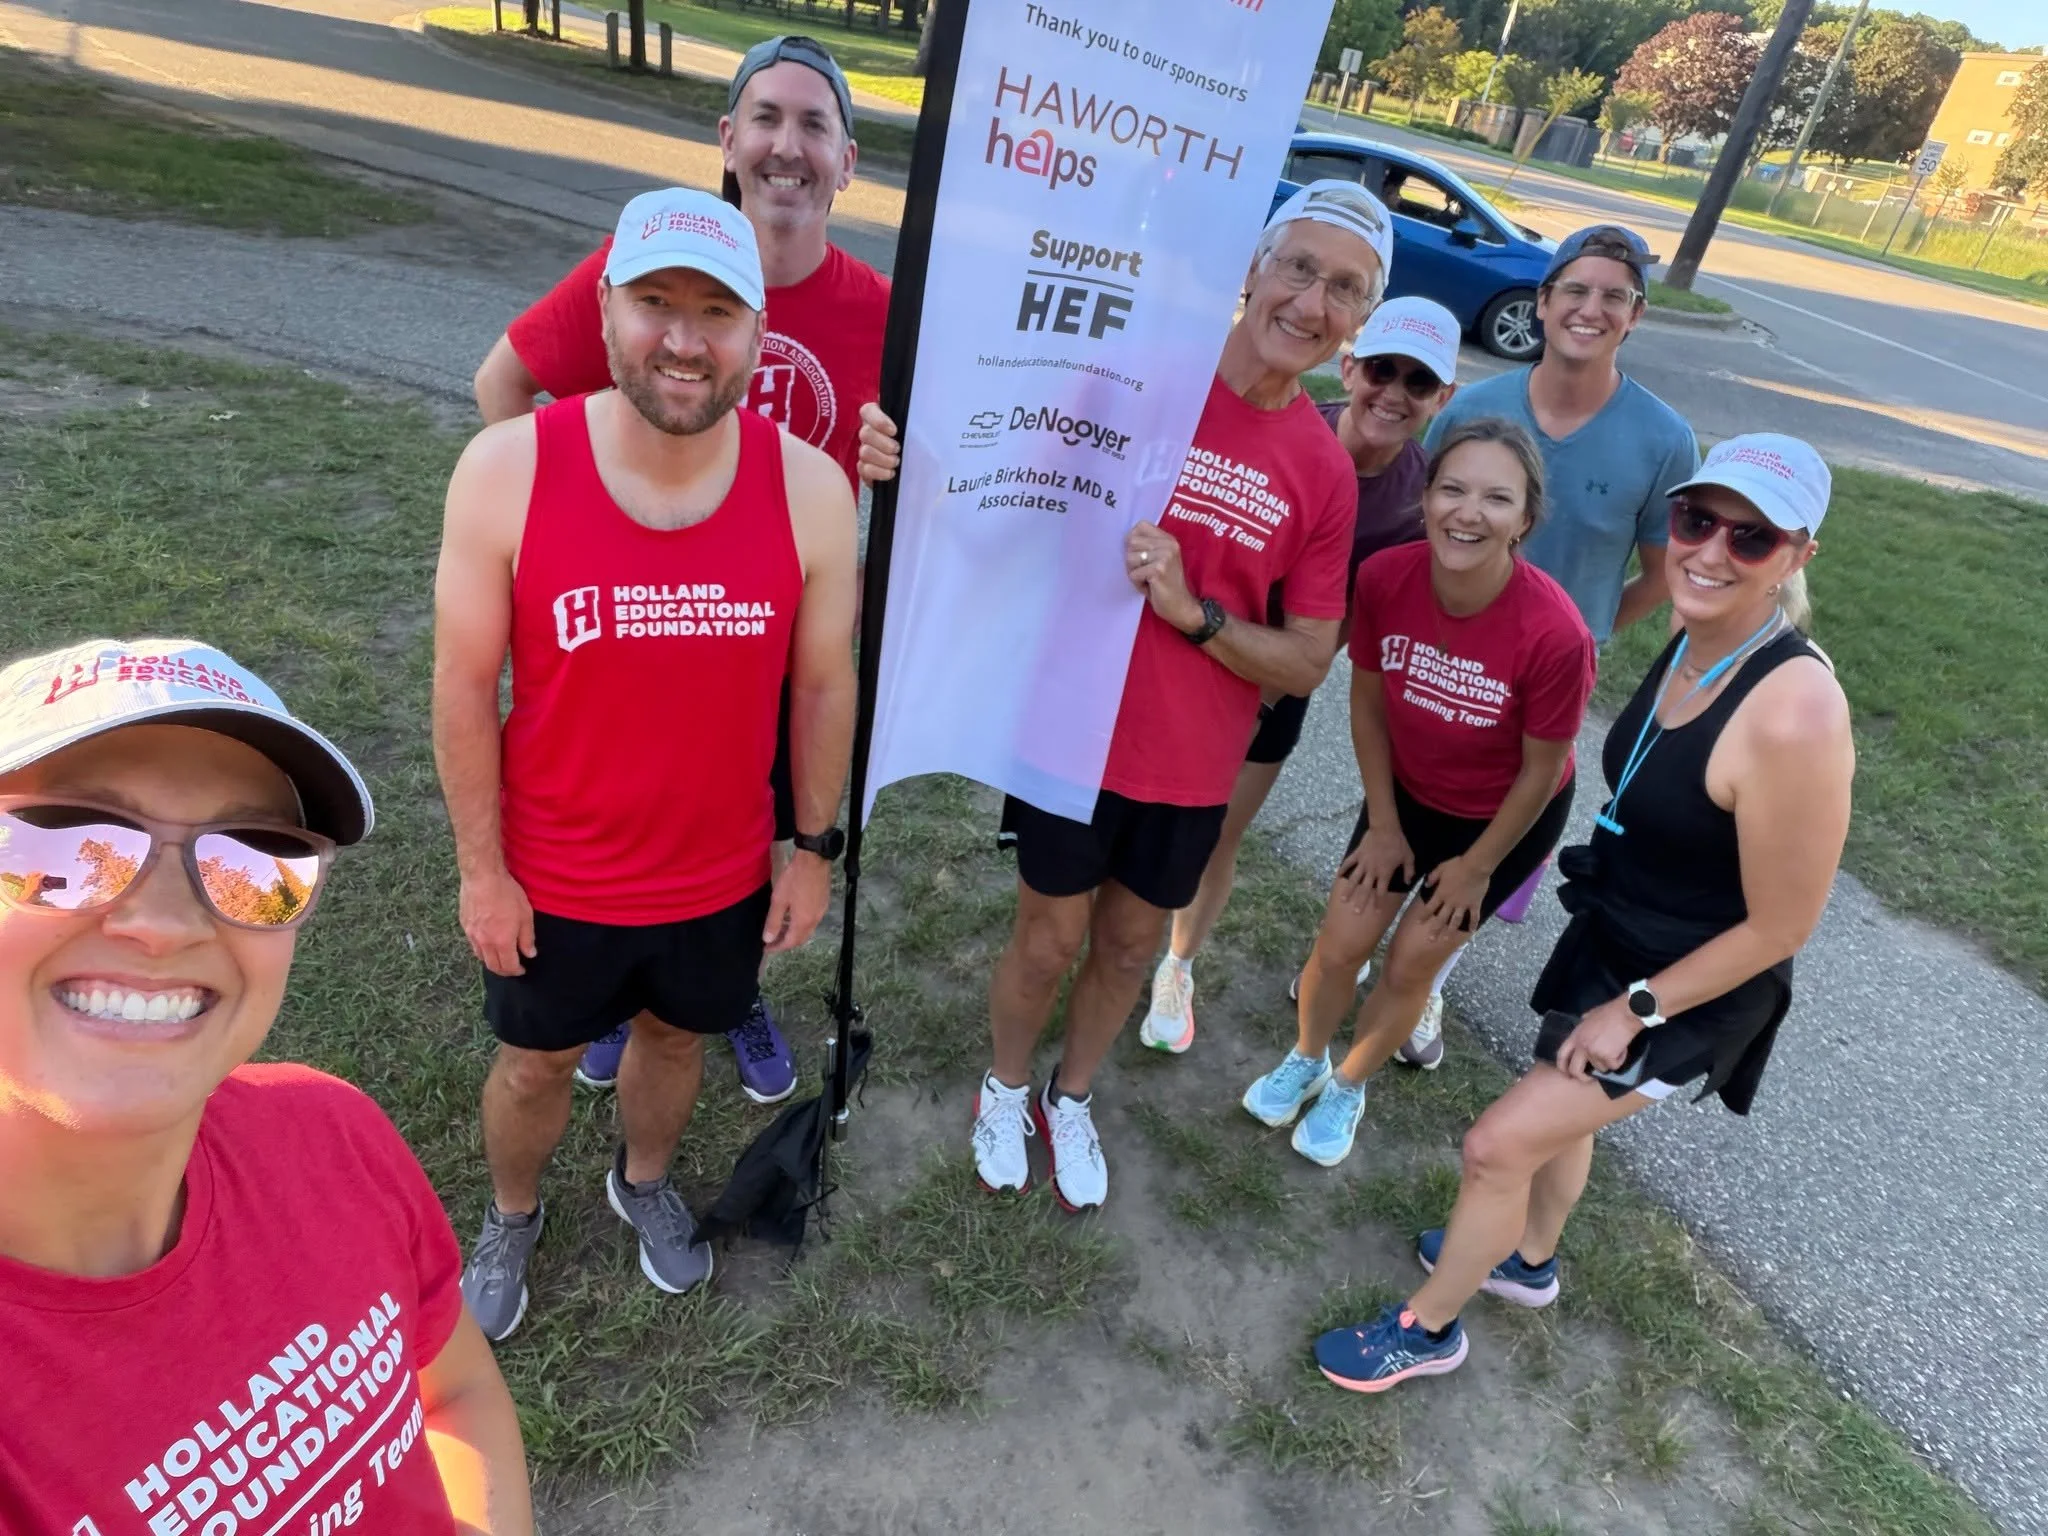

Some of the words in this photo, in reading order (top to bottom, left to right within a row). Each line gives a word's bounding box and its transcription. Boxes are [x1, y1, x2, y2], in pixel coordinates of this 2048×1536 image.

[1025, 3, 1082, 41] Thank
[1087, 29, 1118, 55] you
[1122, 38, 1139, 60] to
[1143, 48, 1168, 72] our
[1169, 60, 1248, 103] sponsors
[994, 65, 1244, 180] HAWORTH
[985, 117, 1097, 190] helps
[1919, 158, 1936, 172] 50
[670, 211, 721, 229] HOLLAND
[1030, 229, 1143, 279] Support
[1016, 282, 1133, 340] HEF
[788, 348, 831, 418] ASSOCIATION
[1008, 405, 1132, 453] DeNooyer
[947, 472, 992, 494] Laurie
[994, 466, 1068, 489] Birkholz
[1072, 475, 1102, 499] MD
[1104, 489, 1118, 509] &
[1182, 461, 1290, 517] EDUCATIONAL
[1188, 446, 1269, 487] HOLLAND
[977, 491, 1069, 514] Associates
[1178, 474, 1282, 527] FOUNDATION
[1168, 503, 1229, 537] Running
[1229, 525, 1266, 553] Team
[613, 583, 726, 602] HOLLAND
[614, 601, 775, 621] EDUCATIONAL
[615, 620, 765, 639] FOUNDATION
[118, 655, 243, 690] HOLLAND
[1410, 654, 1512, 698] EDUCATIONAL
[1413, 641, 1484, 675] HOLLAND
[1403, 689, 1456, 722] Running
[1458, 709, 1498, 728] Team
[1408, 666, 1504, 706] FOUNDATION
[124, 1323, 328, 1513] HOLLAND
[148, 1292, 401, 1536] EDUCATIONAL
[201, 1329, 404, 1536] OUNDATION
[368, 1397, 423, 1488] Team
